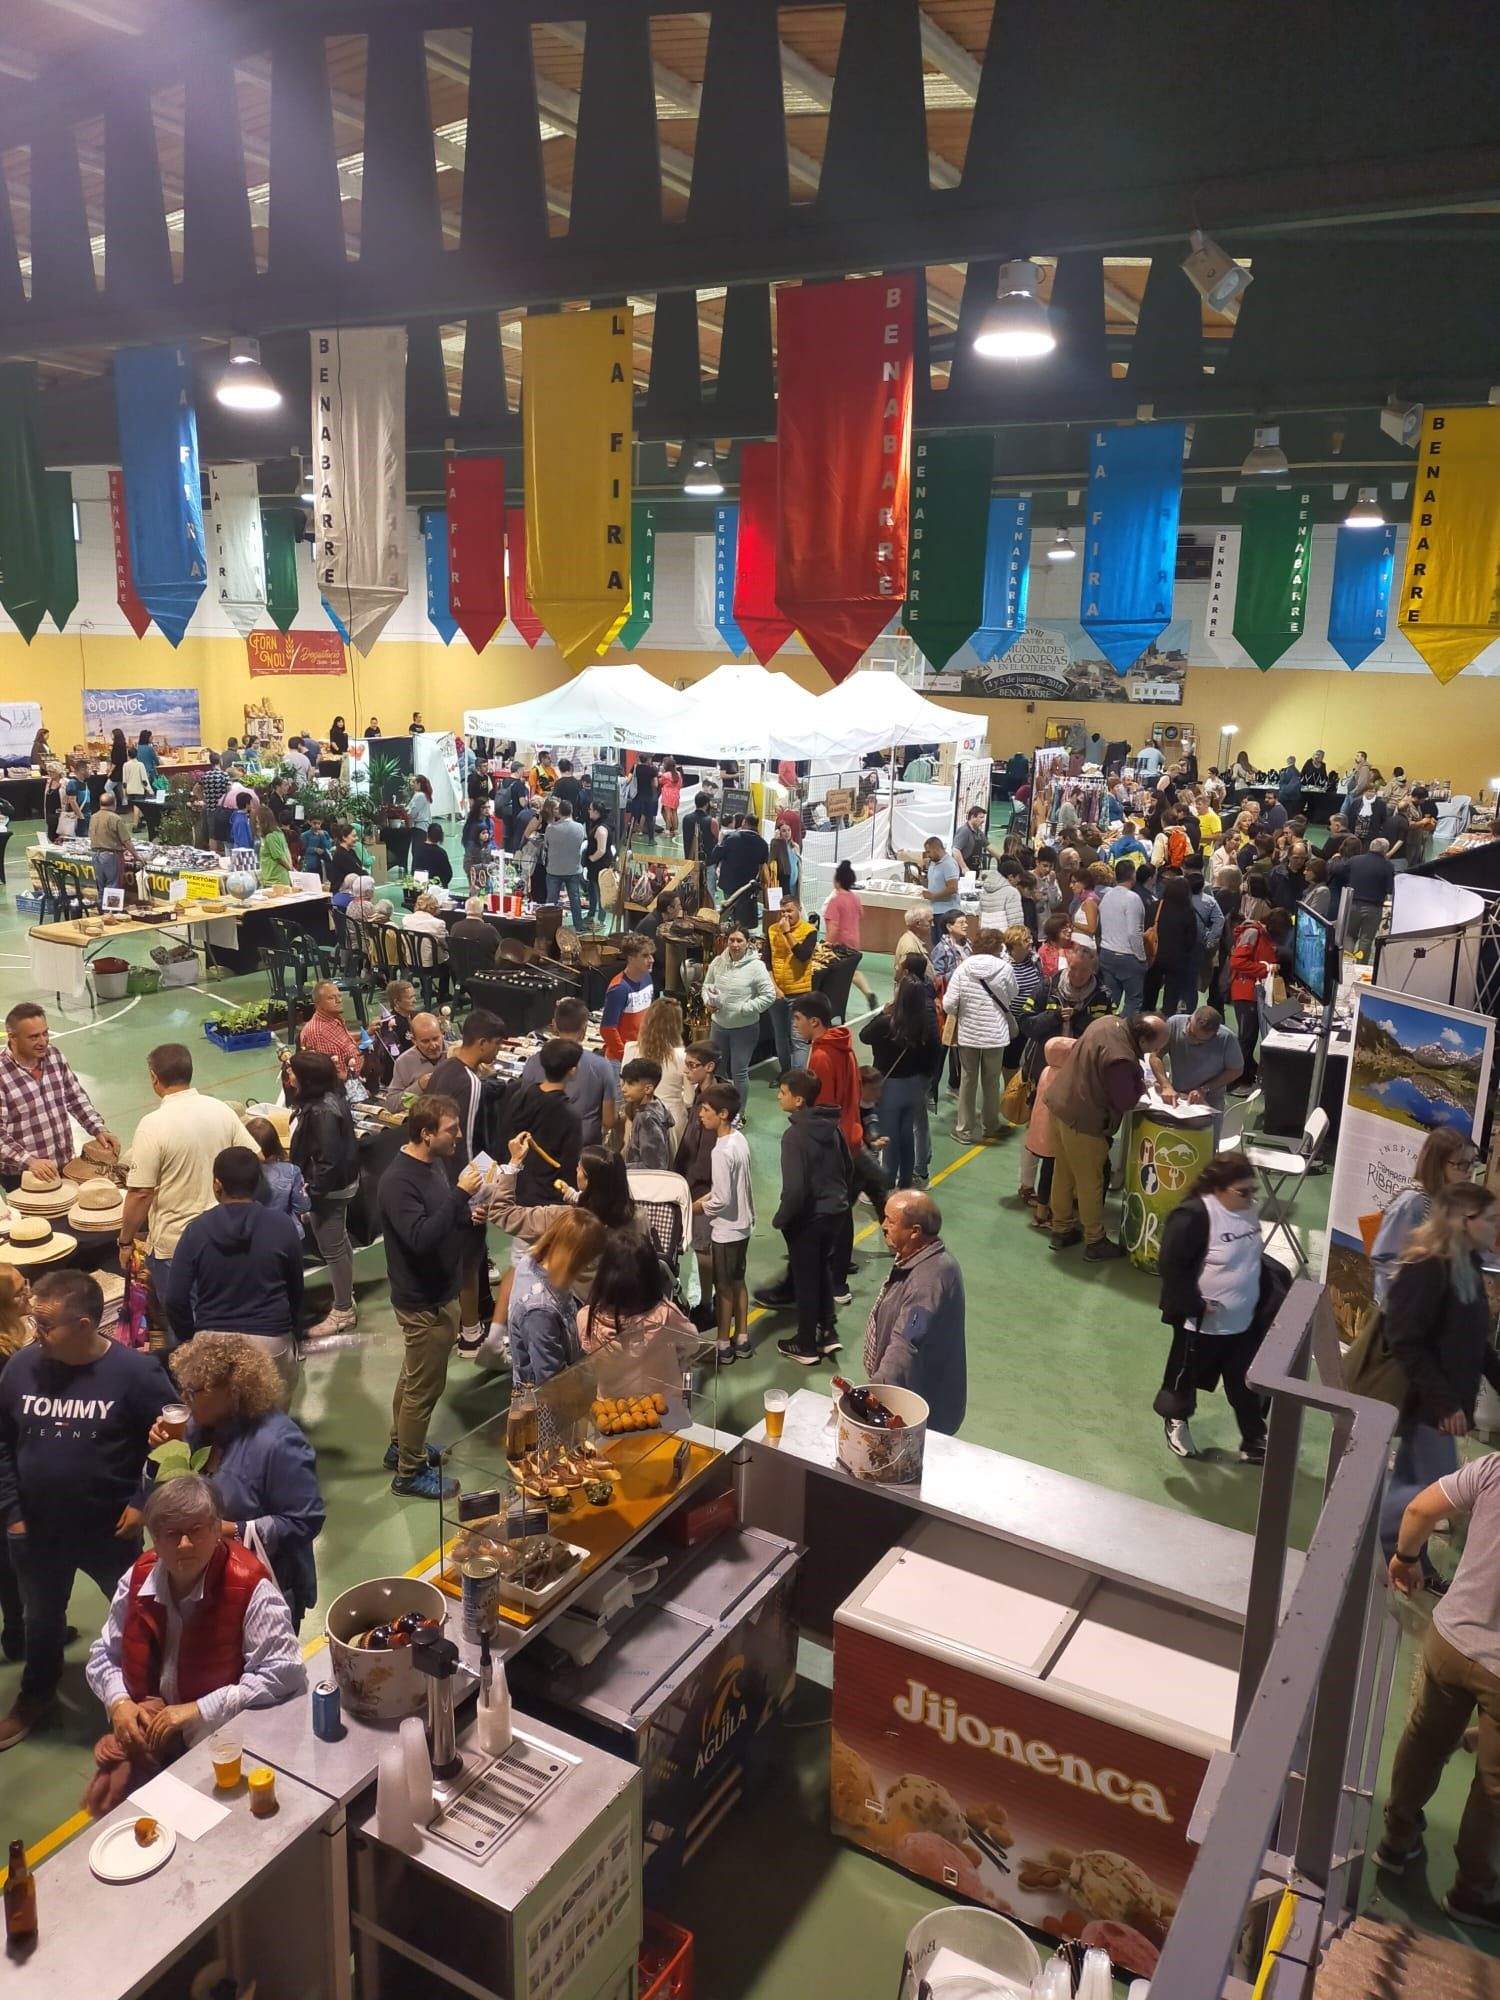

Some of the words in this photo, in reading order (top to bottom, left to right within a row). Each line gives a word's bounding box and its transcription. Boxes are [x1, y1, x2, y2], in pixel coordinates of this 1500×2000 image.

[177, 350, 187, 405] LA
[611, 315, 624, 382] LA
[319, 338, 334, 583] BENABARRE
[449, 463, 457, 498] LA
[878, 288, 901, 594] BENABARRE
[1095, 433, 1107, 479] LA
[112, 476, 126, 602] BENABARRE
[212, 470, 220, 502] LA
[216, 523, 228, 599] FIRA
[607, 433, 624, 589] FIRA
[646, 509, 653, 537] LA
[909, 445, 927, 620] BENABARRE
[1383, 529, 1392, 556] LA
[1407, 417, 1445, 622] BENABARRE
[451, 524, 461, 608] FIRA
[643, 555, 651, 619] FIRA
[1007, 502, 1025, 628] BENABARRE
[1086, 511, 1103, 616] FIRA
[1209, 534, 1227, 637] BENABARRE
[1291, 494, 1310, 632] BENABARRE
[1000, 688, 1050, 697] BENABARRE
[22, 1394, 116, 1420] TOMMY
[27, 1427, 97, 1440] JEANS
[893, 1678, 1174, 1824] Jijonenca
